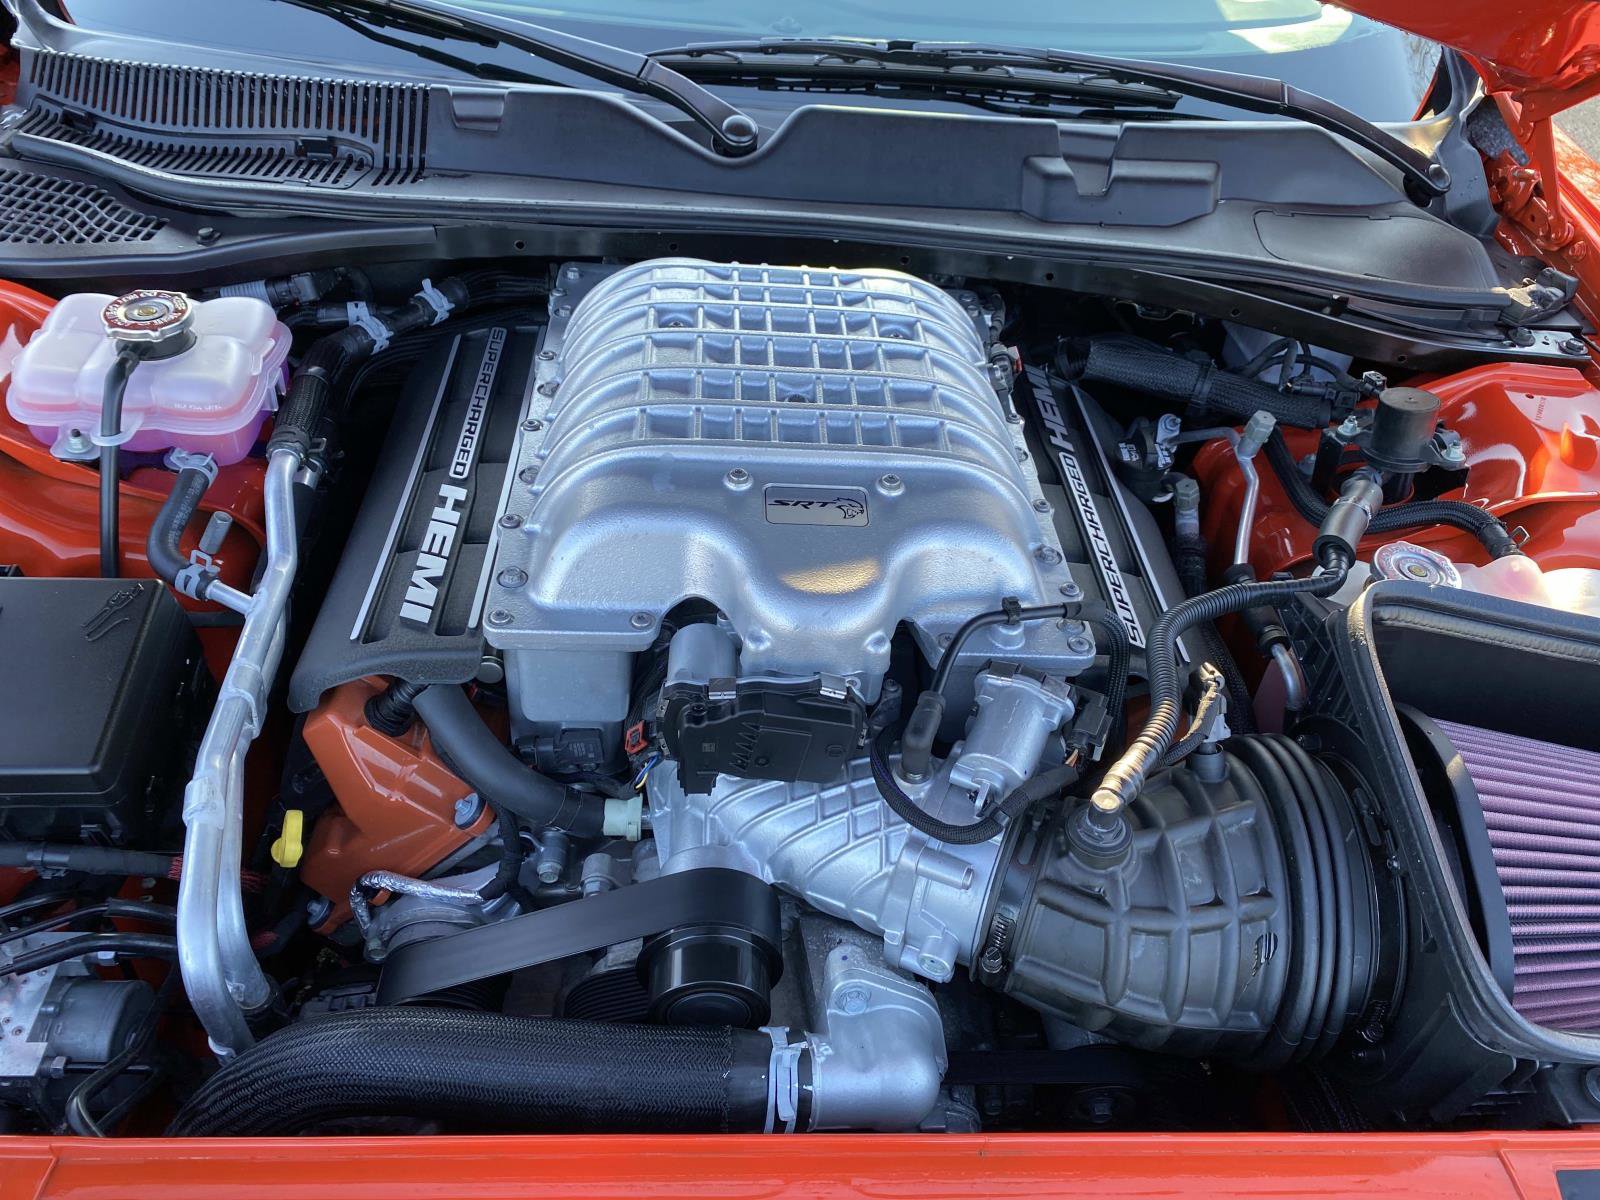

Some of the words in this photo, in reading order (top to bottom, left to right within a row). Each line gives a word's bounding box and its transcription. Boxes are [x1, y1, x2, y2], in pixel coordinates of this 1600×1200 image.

[452, 328, 505, 477] SUPERCHARGED
[1023, 363, 1075, 453] HEMI
[399, 483, 468, 624] HEMI
[767, 499, 838, 510] SRT
[1063, 454, 1145, 648] SUPERCHARGED
